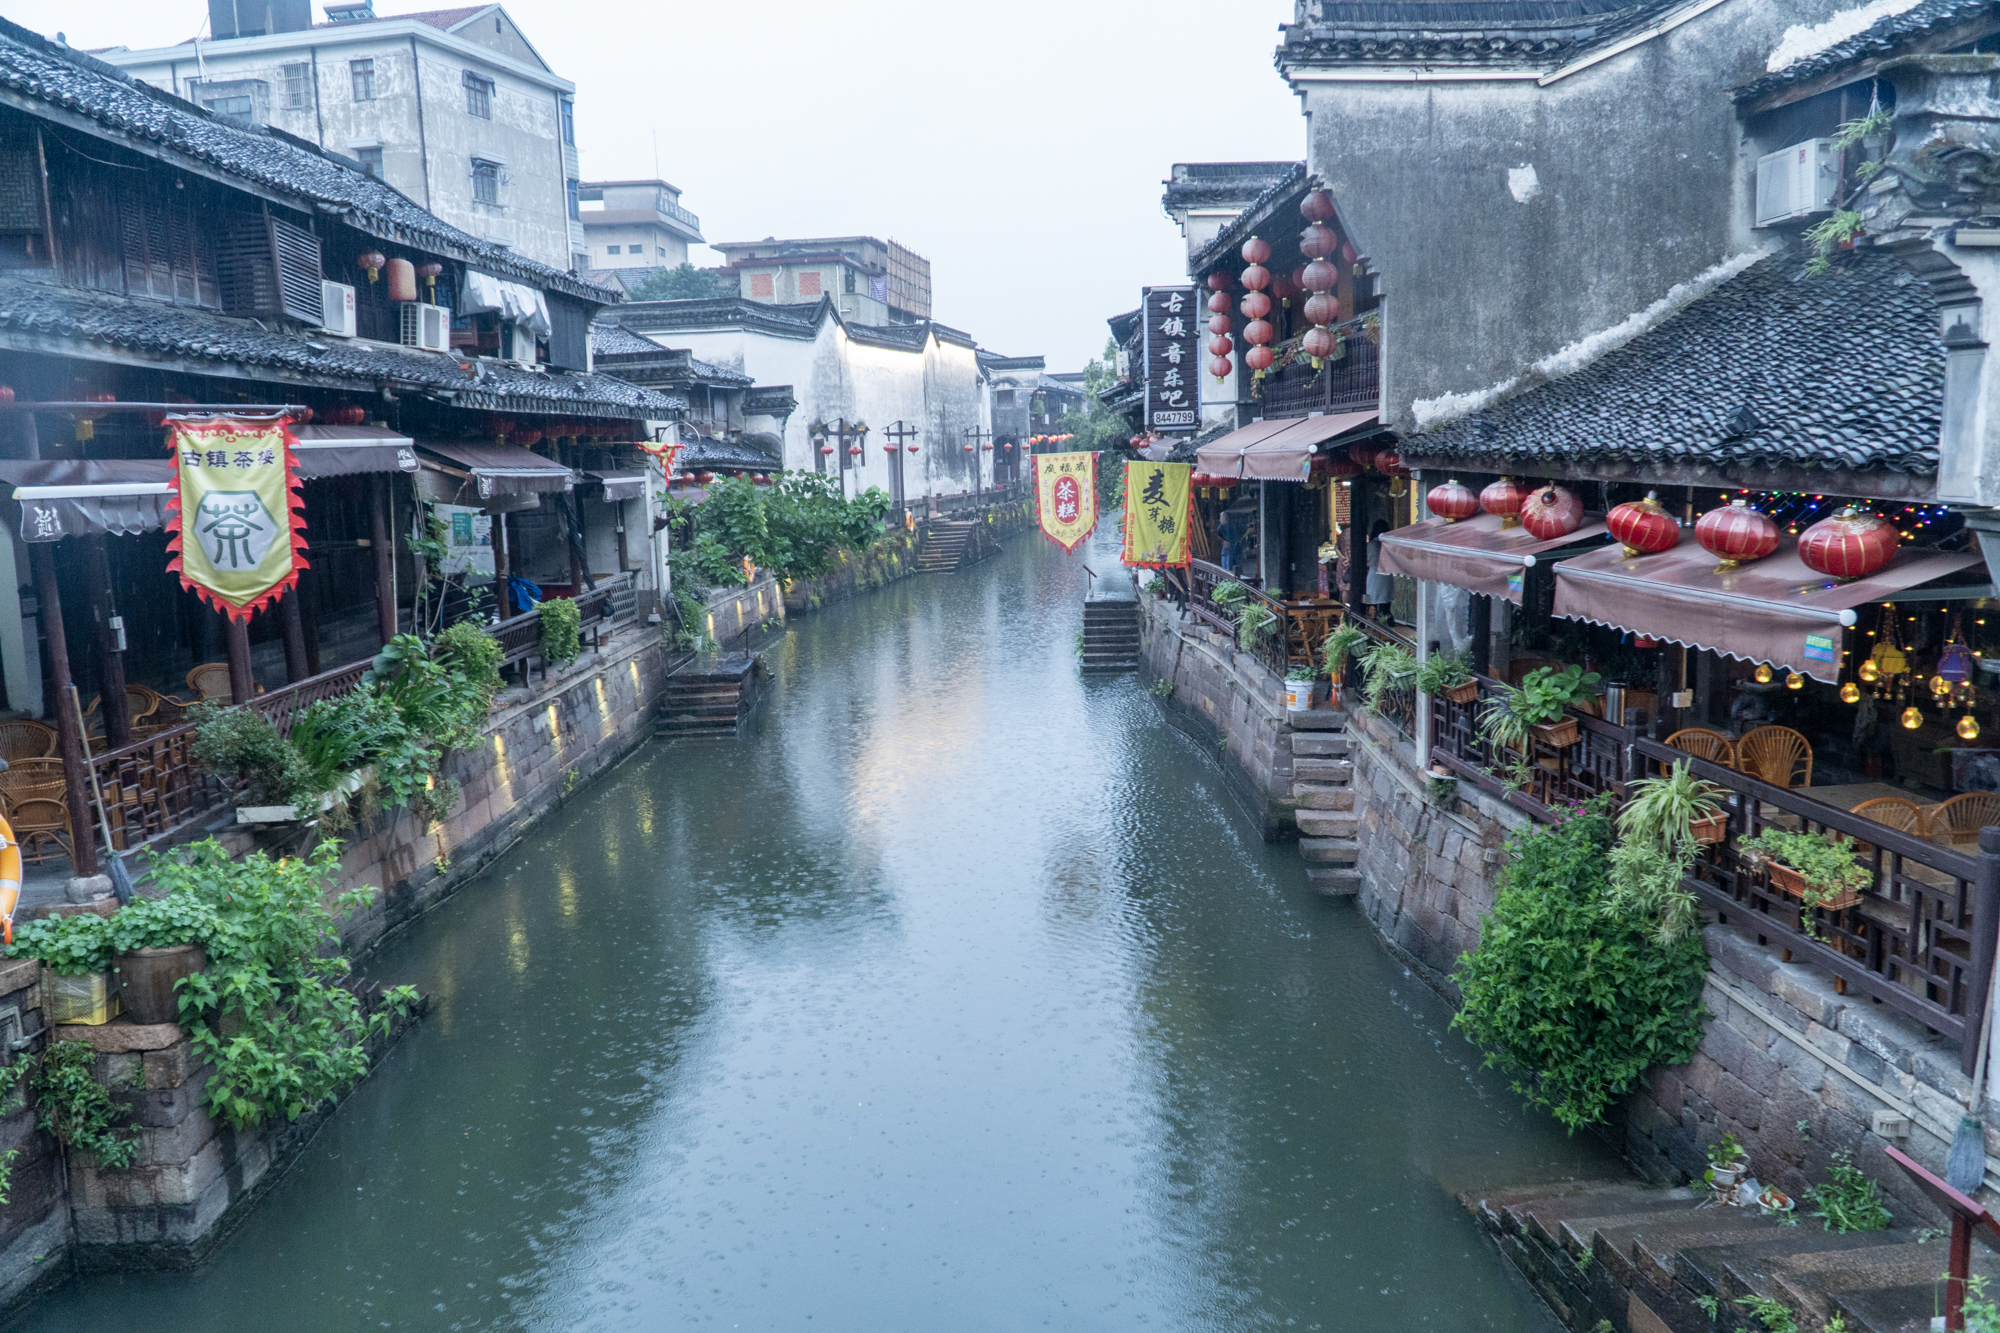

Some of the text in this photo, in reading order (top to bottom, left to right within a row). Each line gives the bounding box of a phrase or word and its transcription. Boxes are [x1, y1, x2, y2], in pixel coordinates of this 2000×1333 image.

[1155, 411, 1193, 424] 8447799
[181, 447, 275, 469] 古镇茶楼
[1056, 481, 1078, 518] 茶糕
[1142, 469, 1176, 534] 麦芽糖
[201, 503, 264, 569] 茶
